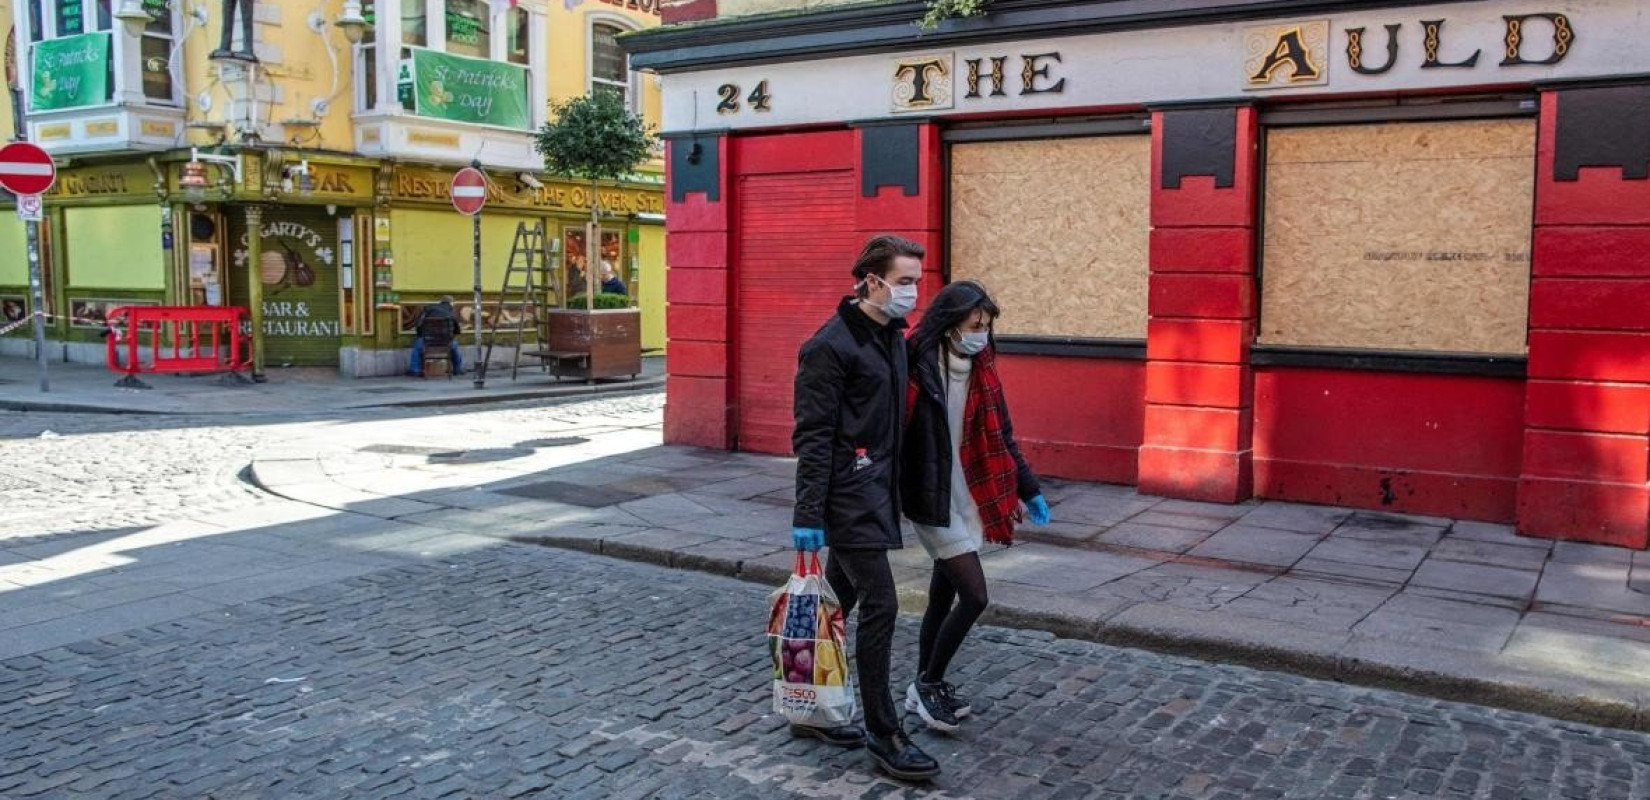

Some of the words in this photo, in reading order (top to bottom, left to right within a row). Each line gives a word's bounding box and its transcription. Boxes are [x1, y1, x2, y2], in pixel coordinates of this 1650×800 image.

[895, 51, 1066, 106] THE
[1249, 12, 1576, 83] AULD
[457, 69, 517, 90] Patricks
[460, 94, 492, 117] Day
[716, 80, 771, 113] 24
[397, 172, 504, 203] RESTANT
[571, 186, 630, 210] OLVER
[294, 301, 310, 317] &
